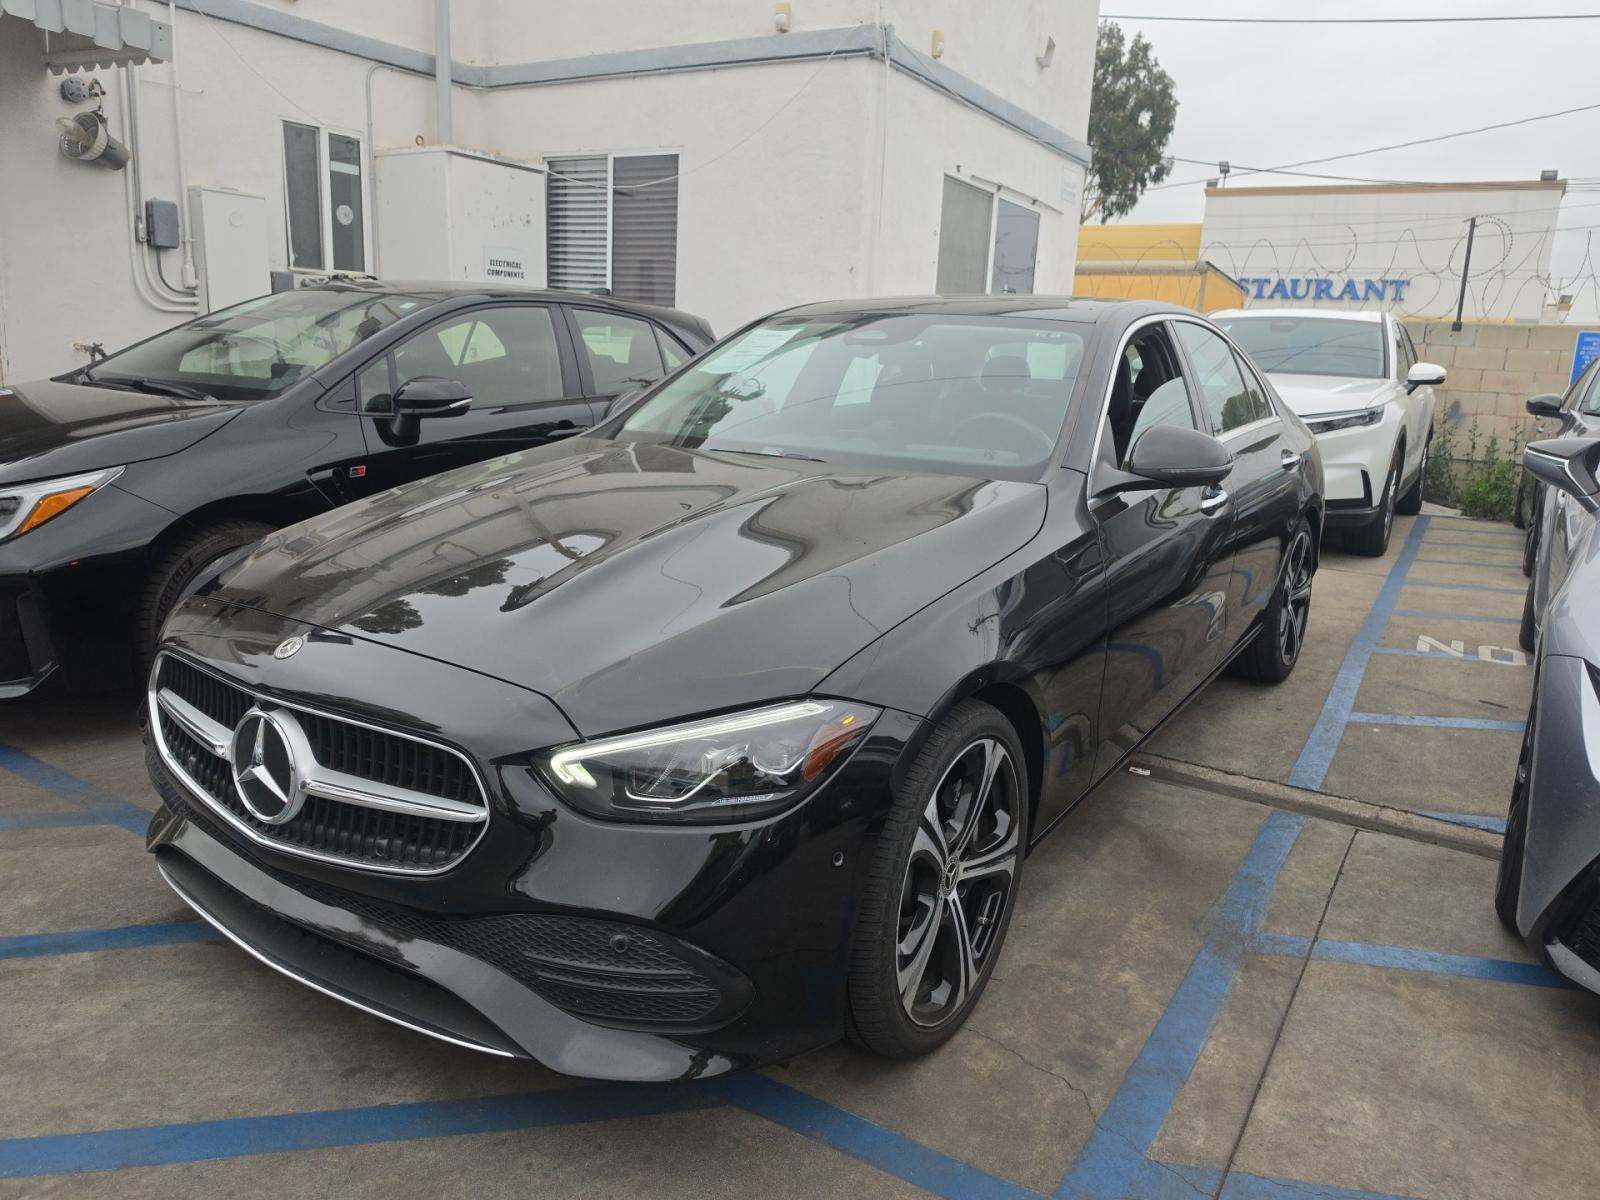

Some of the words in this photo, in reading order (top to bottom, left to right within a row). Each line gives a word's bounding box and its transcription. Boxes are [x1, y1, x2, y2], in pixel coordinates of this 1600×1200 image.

[489, 259, 522, 269] ELECTRICAL
[487, 268, 525, 279] COMPONENTS
[1416, 634, 1528, 666] NO
